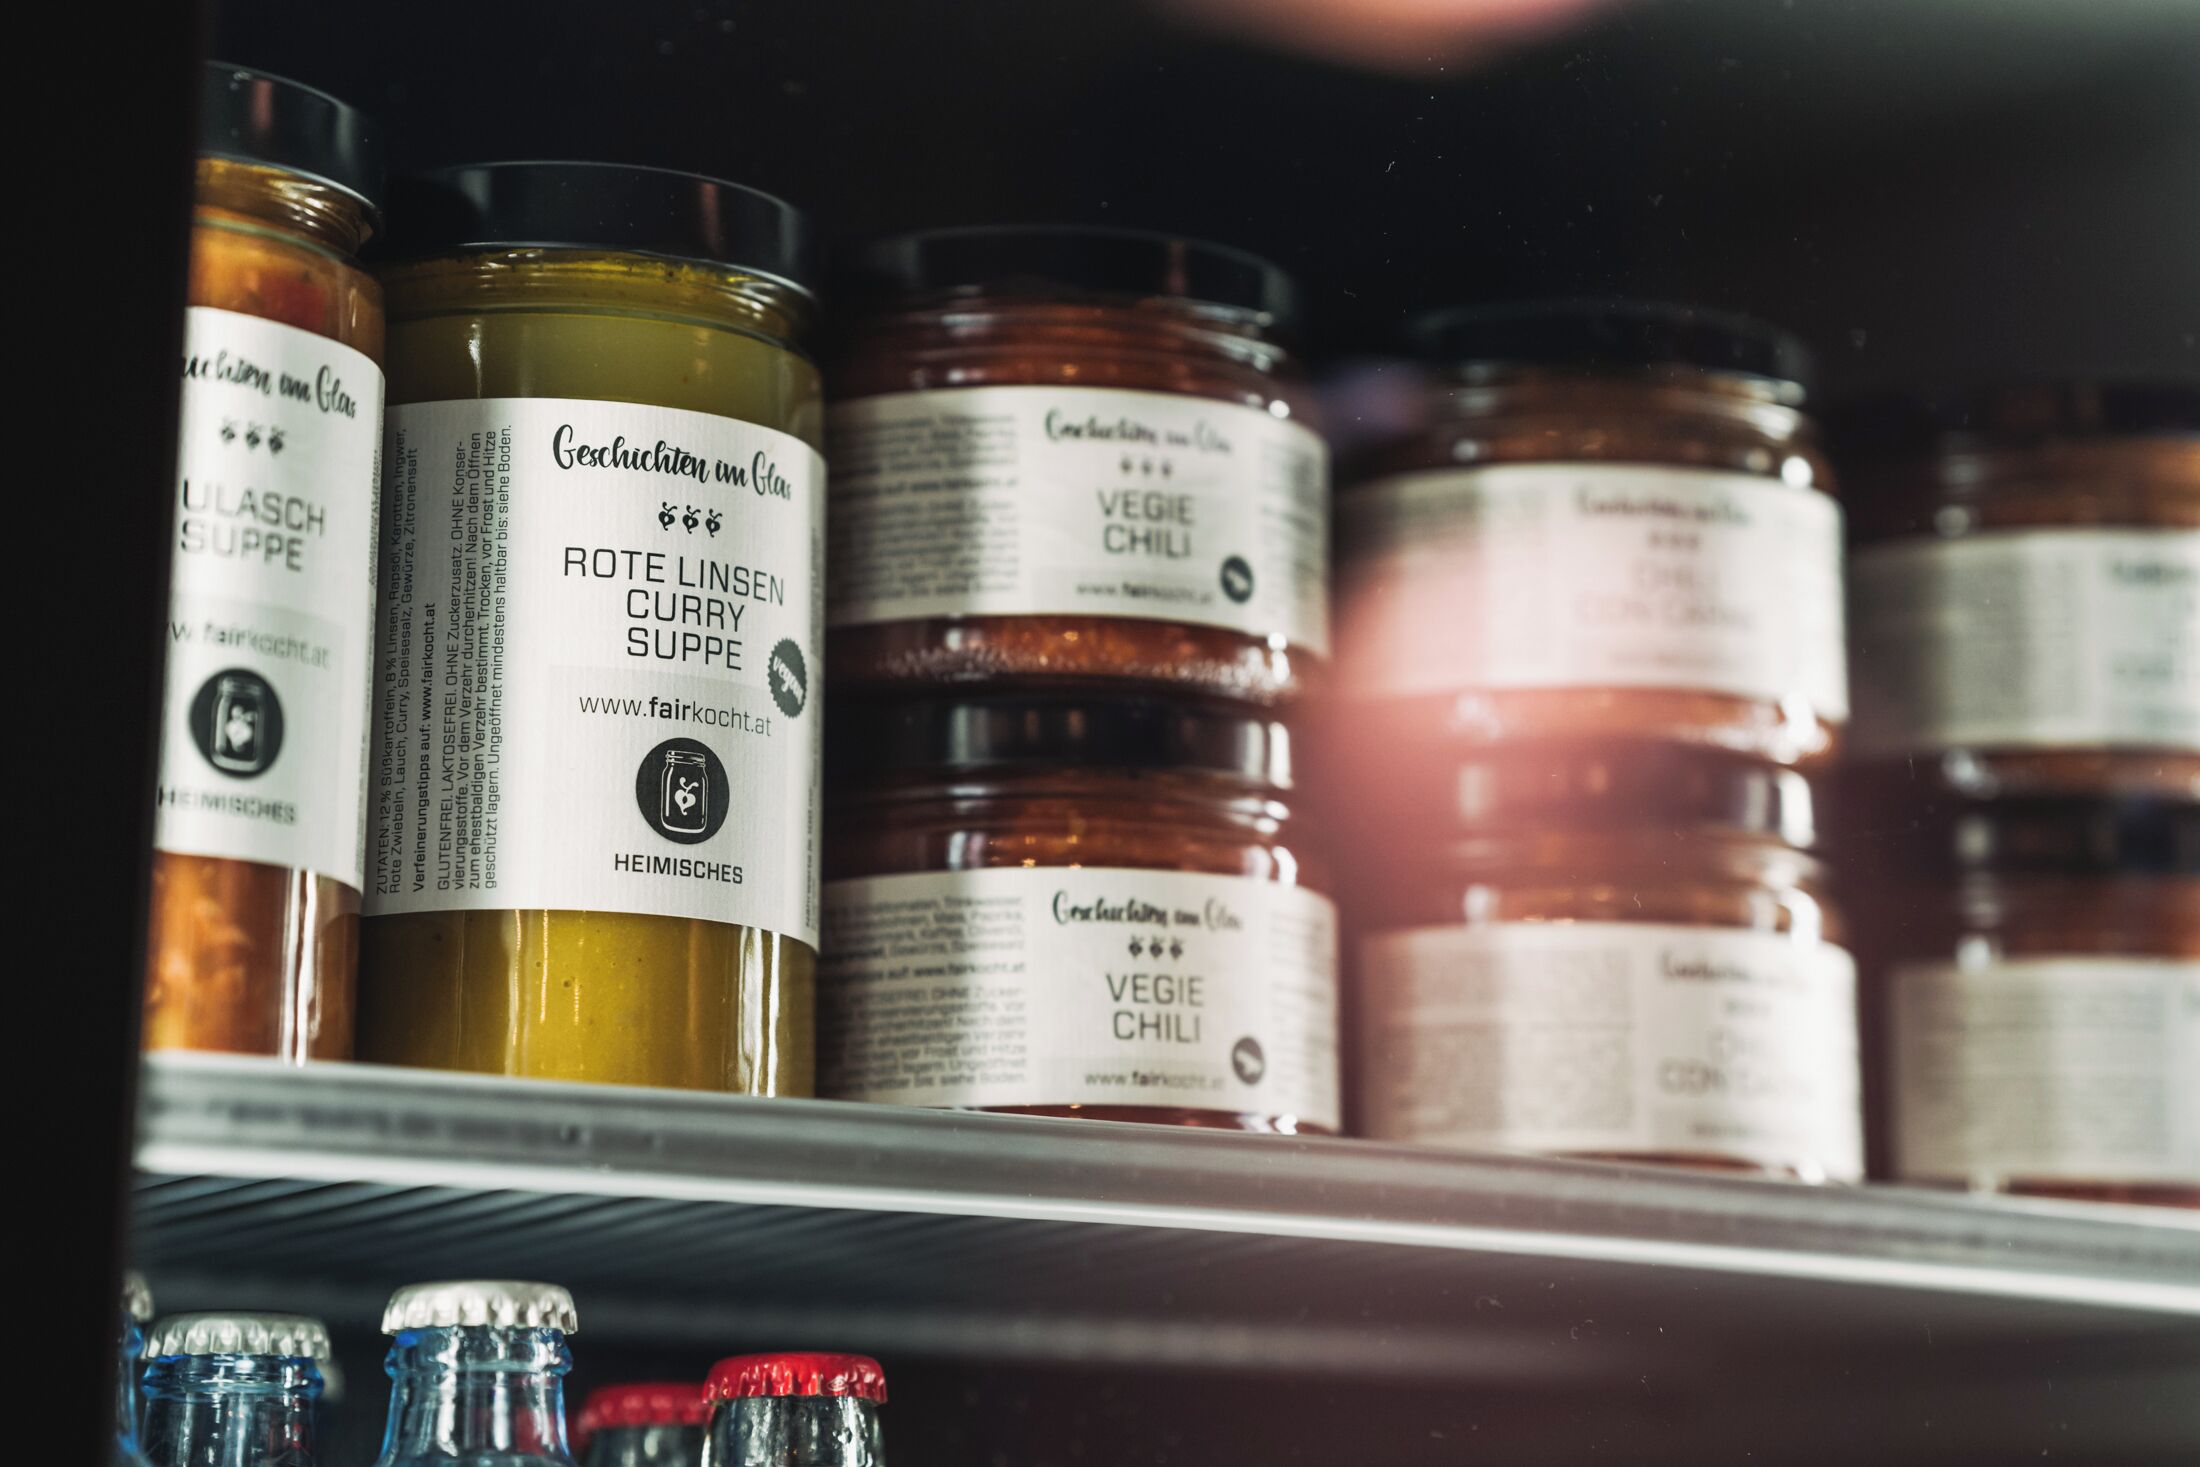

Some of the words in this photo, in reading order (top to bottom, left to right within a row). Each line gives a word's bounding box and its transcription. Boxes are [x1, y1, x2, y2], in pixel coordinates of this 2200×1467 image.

[394, 429, 406, 478] Ingwer,
[453, 441, 465, 494] Konser-
[466, 433, 480, 478] Öffnen
[483, 431, 495, 465] Hitze
[498, 425, 511, 471] Boden.
[553, 423, 710, 483] Geschichten
[715, 459, 748, 488] im
[752, 451, 791, 501] Glas
[404, 448, 417, 535] Zitronensaft
[467, 483, 479, 513] dem
[483, 470, 494, 495] und
[496, 477, 510, 513] siehe
[1097, 488, 1196, 524] VEGIE
[392, 481, 404, 545] Karotten,
[451, 499, 463, 539] OHNE
[465, 517, 478, 552] Nach
[481, 499, 494, 533] Frost
[496, 517, 508, 539] bis:
[180, 518, 303, 572] SUPPE
[482, 538, 492, 559] vor
[1104, 524, 1191, 559] CHILI
[389, 549, 402, 600] Rapsöl,
[402, 539, 415, 603] Gewürze,
[448, 544, 462, 640] Zuckerzusatz.
[477, 563, 492, 619] Trocken,
[494, 544, 507, 593] haltbar
[564, 547, 665, 583] ROTE
[678, 556, 784, 606] LINSEN
[387, 603, 400, 653] Linsen,
[463, 558, 476, 659] durcherhitzen!
[626, 588, 745, 632] CURRY
[399, 607, 413, 687] Speisesalz,
[421, 603, 435, 720] www.fairkocht.at
[475, 623, 489, 692] bestimmt.
[491, 597, 505, 680] mindestens
[626, 627, 742, 670] SUPPE
[446, 644, 458, 685] OHNE
[771, 657, 803, 704] vegan
[397, 691, 410, 733] Curry,
[460, 664, 473, 717] Verzehr
[381, 686, 396, 786] Süßkartoffeln,
[420, 724, 431, 750] auf:
[458, 722, 470, 752] dem
[473, 697, 485, 750] Verzehr
[488, 684, 502, 763] Ungeöffnet
[579, 694, 771, 737] www.fairkocht.at
[395, 737, 407, 783] Lauch,
[442, 690, 457, 791] LAKTOSEFREI.
[457, 757, 469, 780] Vor
[486, 768, 500, 814] lagern.
[392, 787, 405, 855] Zwiebeln,
[413, 755, 430, 892] Verfeinerungstipps
[469, 754, 485, 854] ehestbaldigen
[377, 824, 390, 895] ZUTATEN:
[438, 795, 453, 890] GLUTENFREI.
[453, 784, 469, 889] vierungsstoffe.
[484, 818, 498, 888] geschützt
[390, 860, 401, 893] Rote
[470, 859, 480, 888] zum
[614, 853, 743, 885] HEIMISCHES
[1106, 972, 1205, 1007] VEGIE
[1113, 1010, 1201, 1043] CHILI
